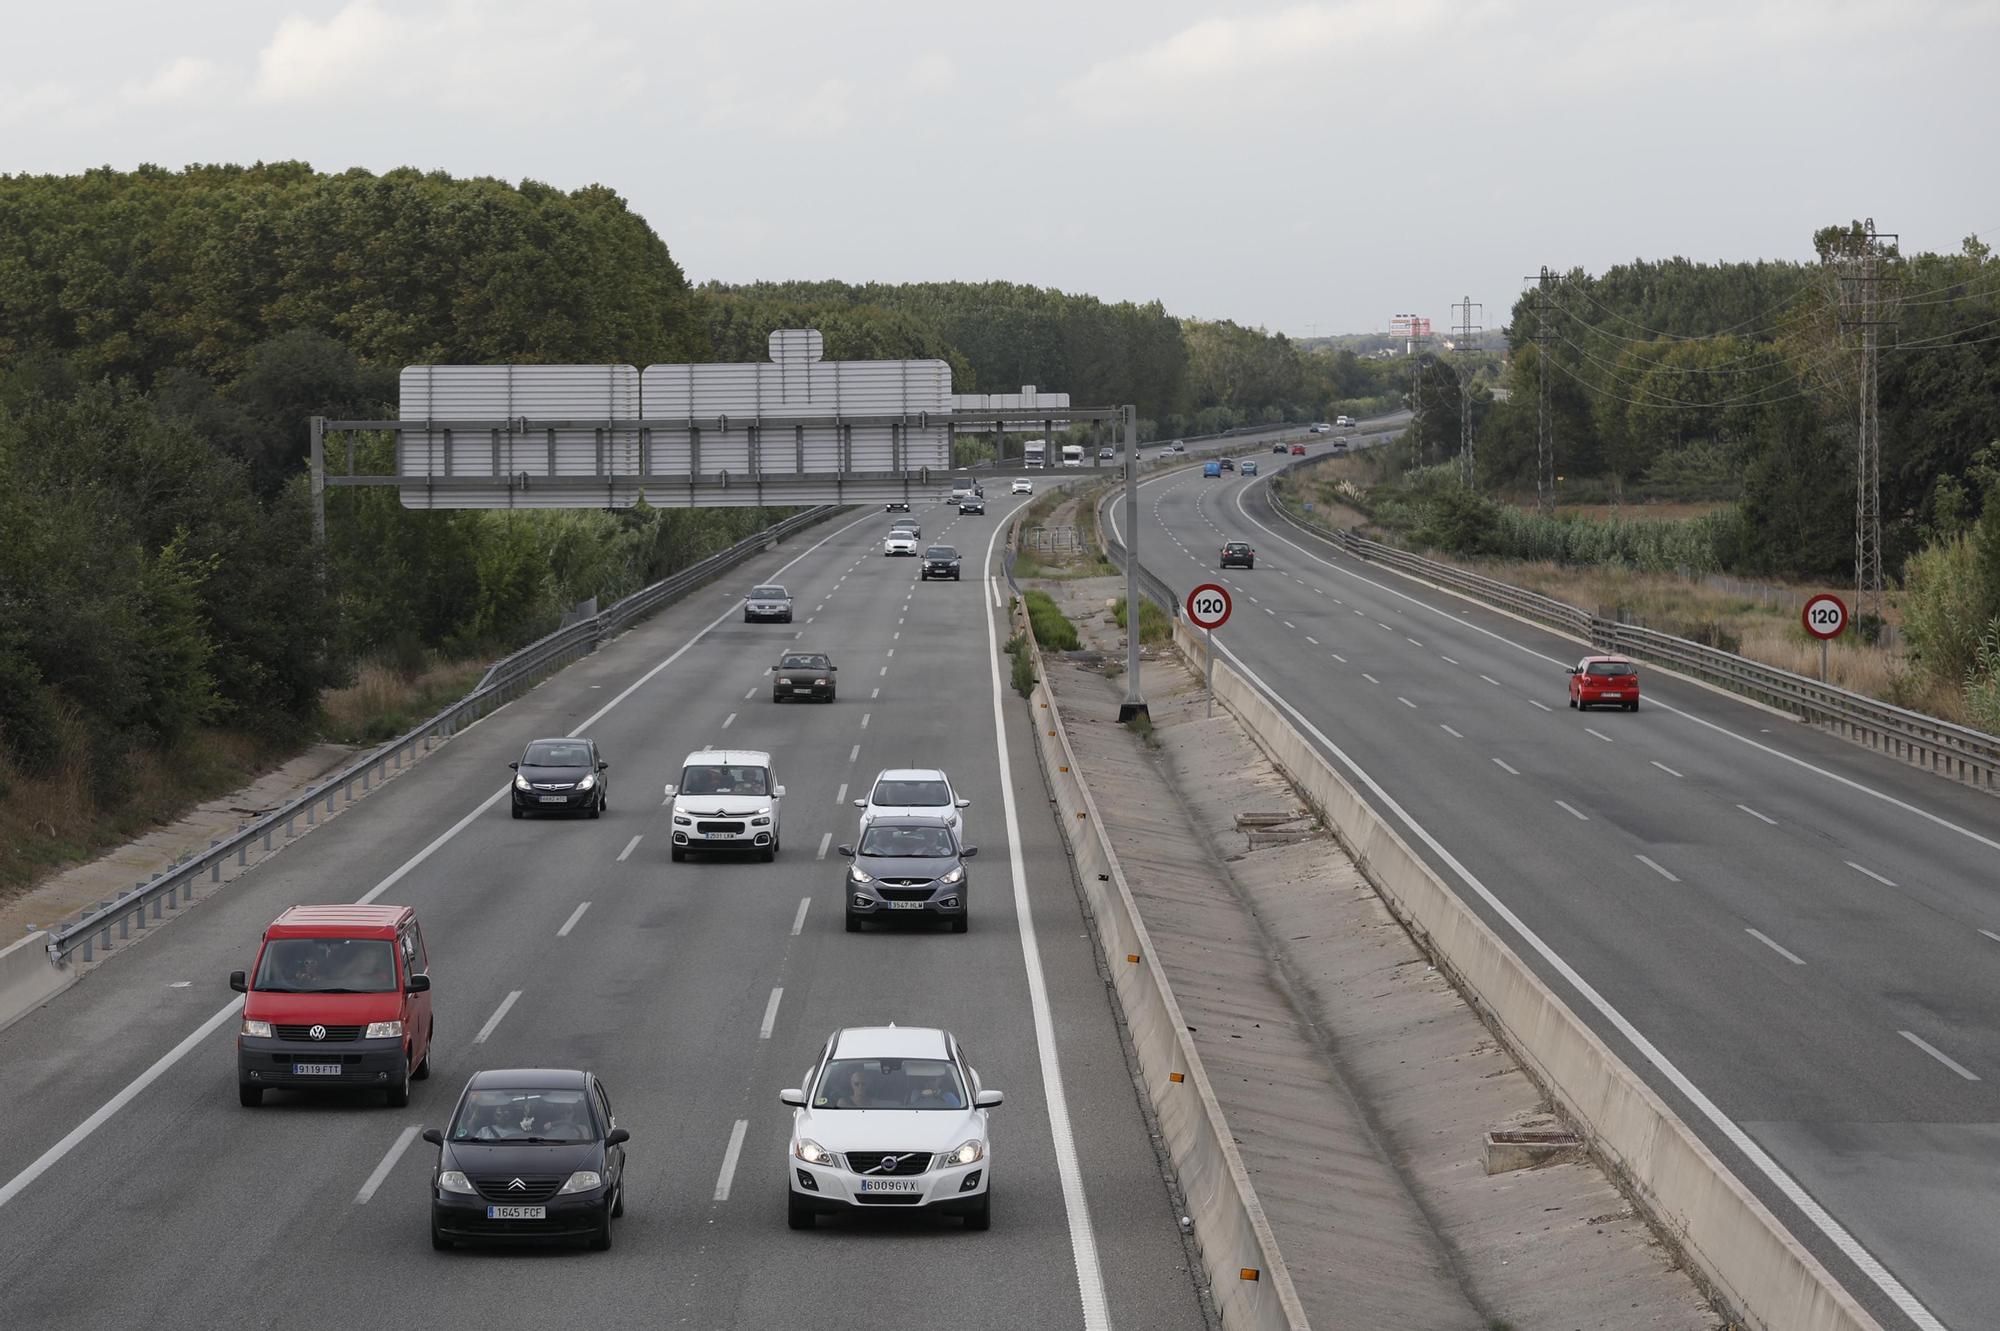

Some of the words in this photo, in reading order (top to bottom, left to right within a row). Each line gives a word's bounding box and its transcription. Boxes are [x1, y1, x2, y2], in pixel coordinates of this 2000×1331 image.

[1196, 599, 1223, 613] 120
[1811, 609, 1838, 624] 120
[299, 1065, 320, 1074] 9119
[323, 1065, 339, 1074] FTT
[867, 1181, 916, 1191] 6009GVX
[497, 1207, 520, 1218] 1645
[523, 1207, 542, 1218] FCF
